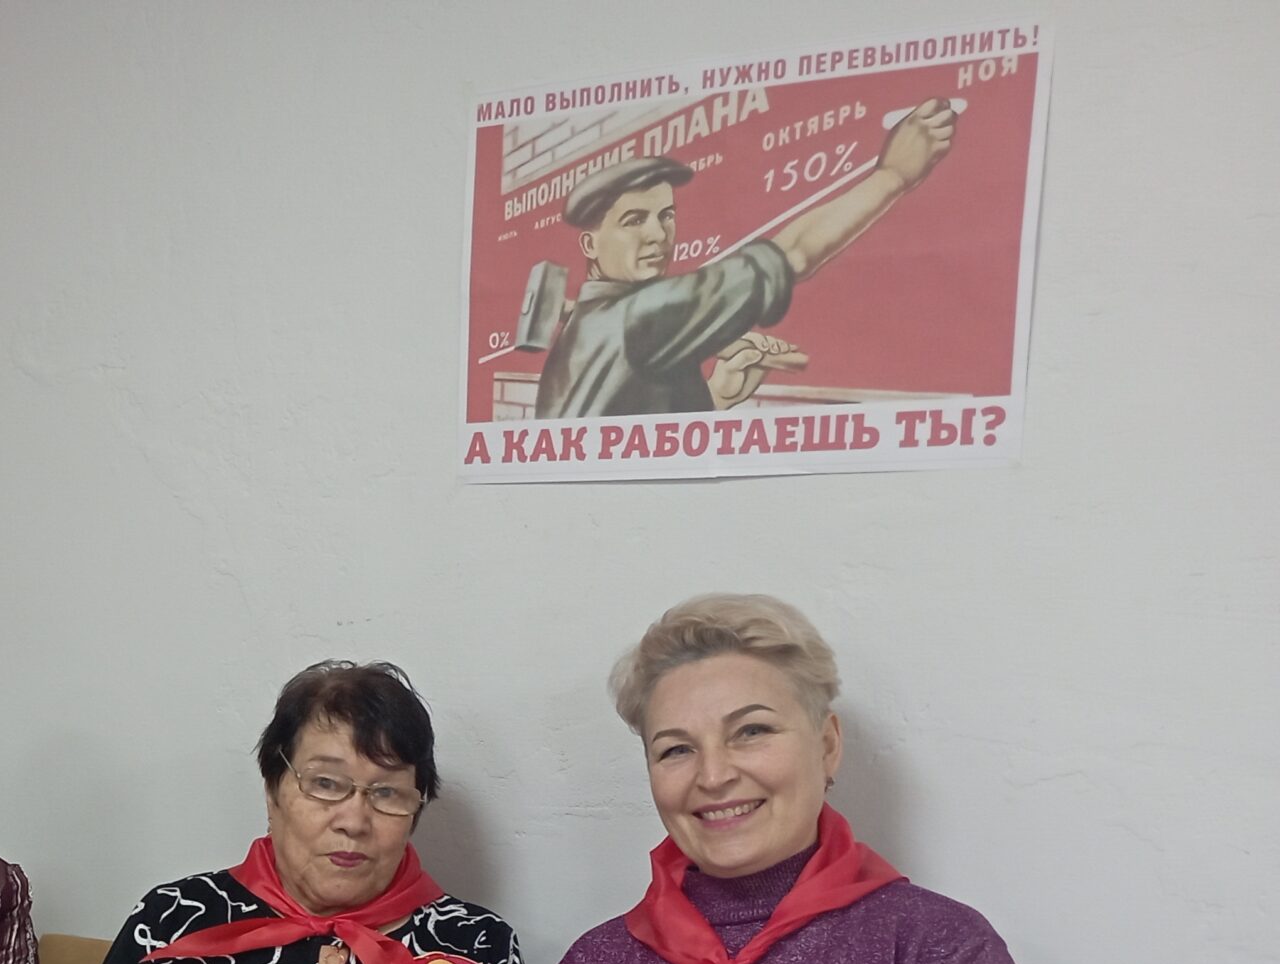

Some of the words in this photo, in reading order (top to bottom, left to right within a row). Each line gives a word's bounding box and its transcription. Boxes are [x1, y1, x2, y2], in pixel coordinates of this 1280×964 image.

[477, 96, 535, 122] МАЛО
[545, 74, 689, 112] ВЫПОЛНИТЬ,
[702, 58, 786, 89] НУЖНО
[798, 25, 1040, 76] ПЕРЕВЫПОЛНИТЬ!
[643, 85, 769, 157] ПЛАНА
[762, 101, 867, 151] ОКТЯБРЬ
[685, 154, 723, 173] ЯБРЬ
[764, 142, 858, 193] 150%
[673, 234, 721, 263] 120%
[489, 332, 510, 349] 0%
[464, 432, 491, 465] А
[502, 426, 588, 463] КАК
[598, 414, 880, 460] РАБОТАЕШЬ
[895, 406, 1007, 449] ТЫ?
